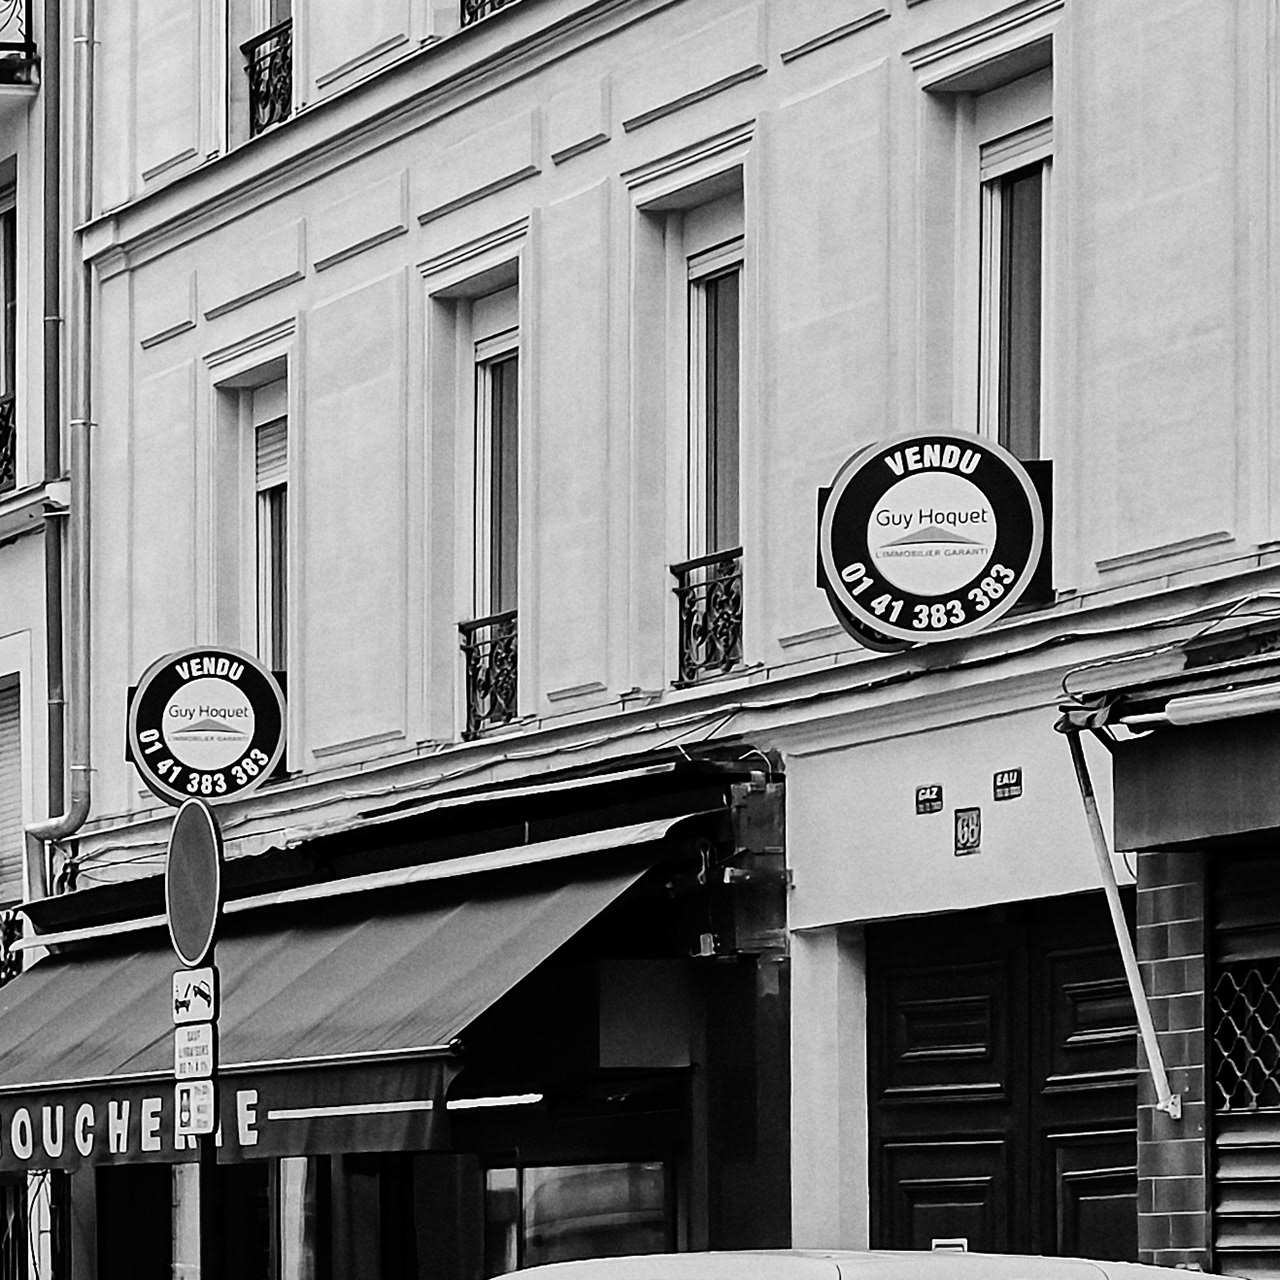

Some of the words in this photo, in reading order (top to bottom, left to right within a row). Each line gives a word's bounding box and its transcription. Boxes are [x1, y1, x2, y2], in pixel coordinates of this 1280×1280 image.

[884, 444, 982, 477] VENDU
[876, 509, 913, 529] Guy
[919, 508, 988, 527] Hoquet
[841, 562, 874, 596] 01
[870, 593, 904, 622] 41
[912, 599, 966, 629] 383
[967, 563, 1015, 611] 383
[175, 657, 245, 681] VENDU
[168, 704, 196, 720] Guy
[198, 704, 249, 719] Hoquet
[139, 728, 163, 755] 01
[156, 758, 183, 784] 41
[186, 772, 227, 794] 383
[231, 748, 269, 785] 383
[996, 772, 1018, 786] EAU
